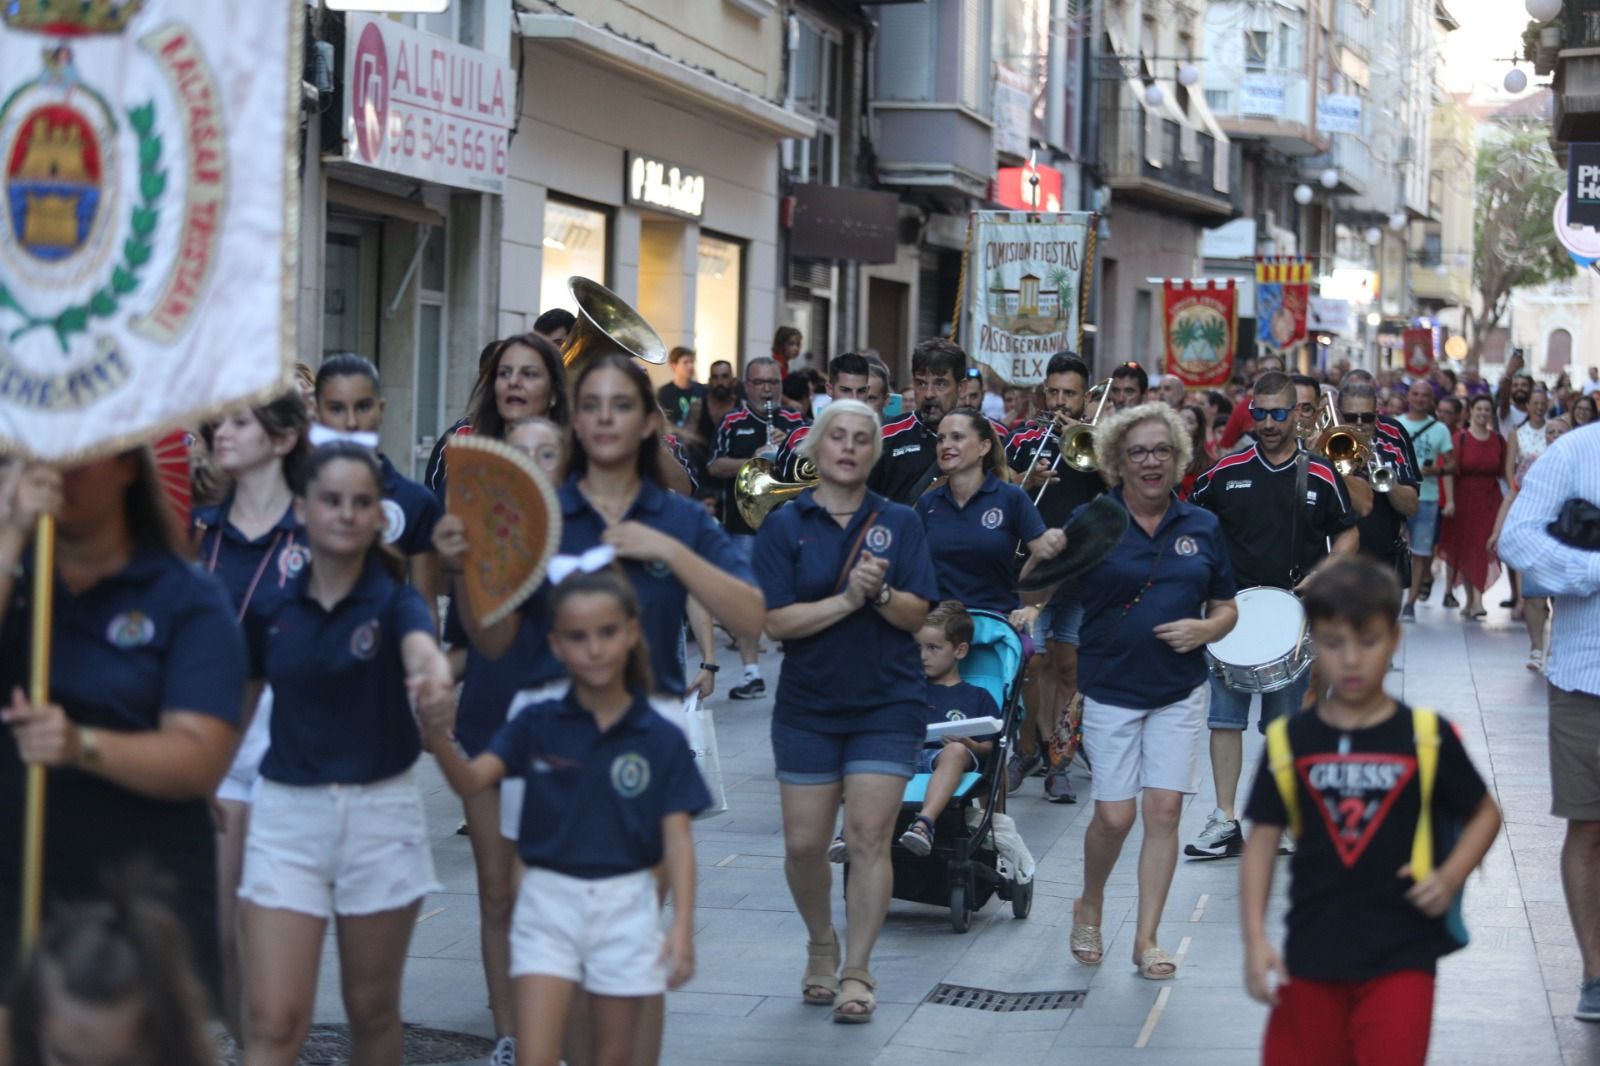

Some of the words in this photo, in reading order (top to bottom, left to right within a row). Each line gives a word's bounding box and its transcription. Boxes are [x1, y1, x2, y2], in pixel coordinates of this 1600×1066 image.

[393, 39, 506, 118] ALQUILA
[389, 110, 416, 163] 96
[421, 117, 458, 166] 545
[462, 127, 486, 171] 66
[491, 132, 506, 176] 16
[985, 241, 1031, 270] COMISION
[1033, 241, 1079, 271] FIESTAS
[980, 324, 1011, 353] PASEO
[1012, 359, 1043, 377] ELX
[1308, 762, 1398, 790] GUESS
